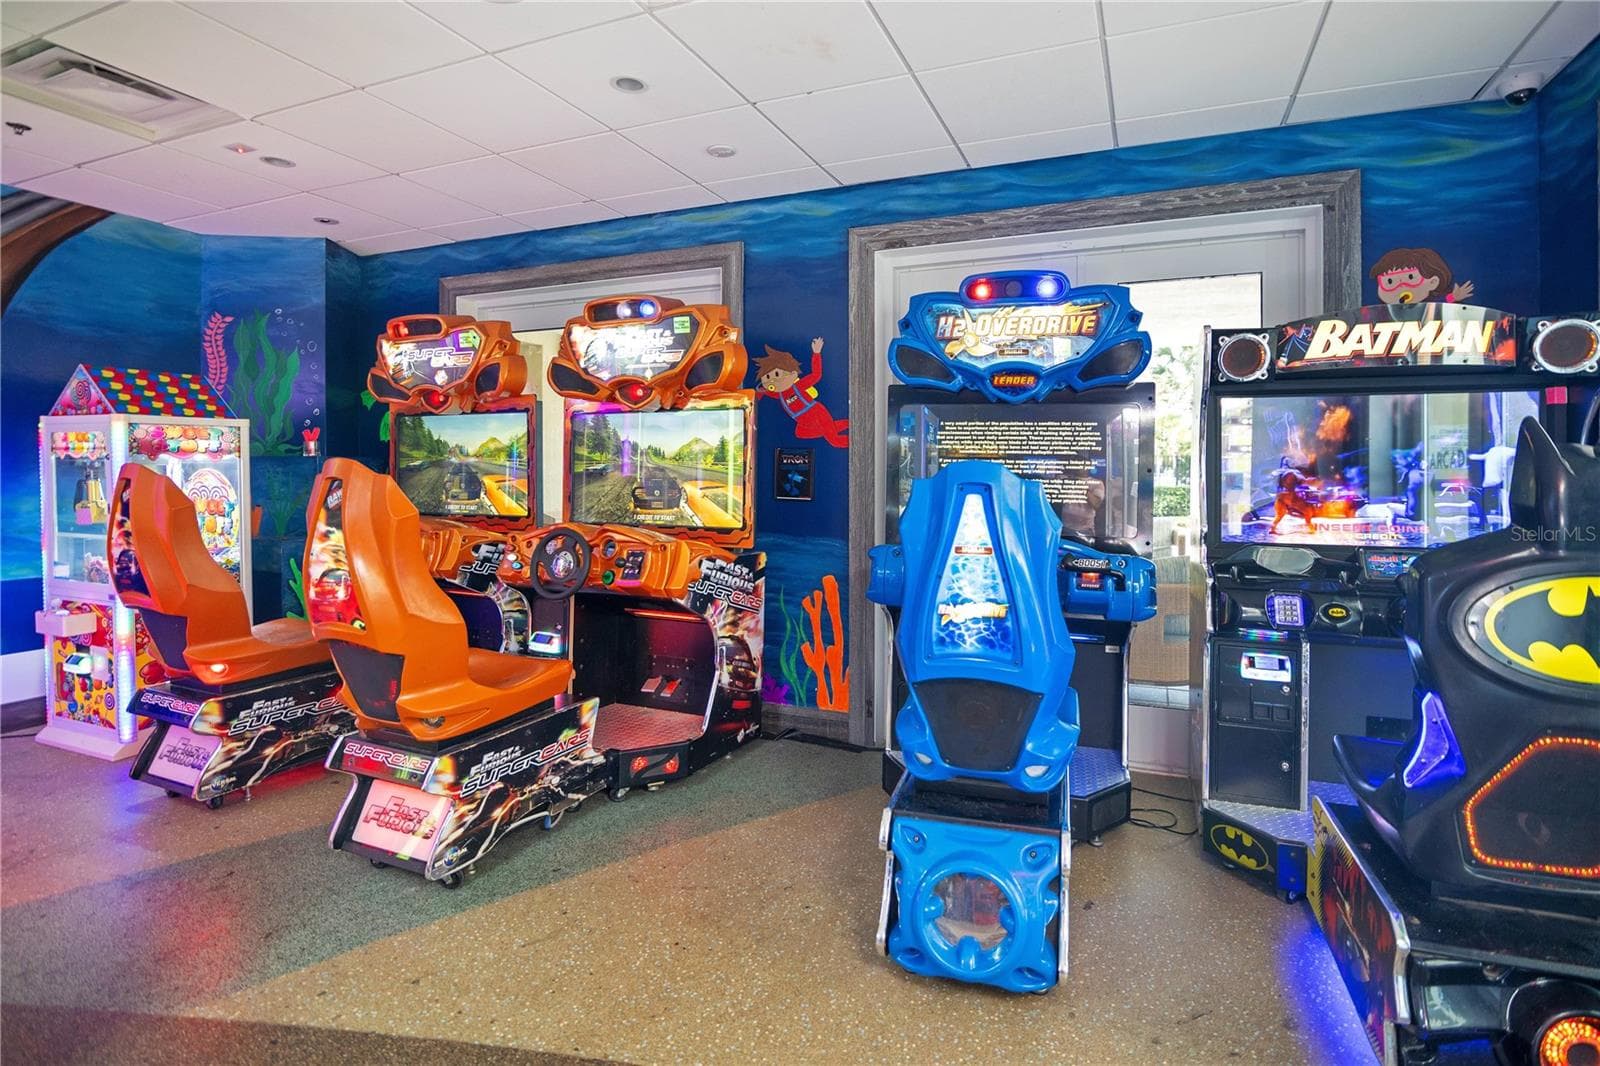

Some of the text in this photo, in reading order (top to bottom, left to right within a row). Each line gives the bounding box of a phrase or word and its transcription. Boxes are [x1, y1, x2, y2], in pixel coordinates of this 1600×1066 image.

[1303, 319, 1497, 361] BATMAN
[993, 374, 1036, 386] LEADER
[781, 455, 809, 464] TRON
[1430, 450, 1466, 469] ARCAD
[715, 558, 750, 577] FAST
[1079, 559, 1108, 569] BOOST
[700, 559, 755, 593] FURIOUS
[141, 692, 200, 717] SUPERCARS
[344, 743, 431, 774] SUPERCARS
[460, 728, 590, 798] SUPERCARS
[469, 751, 522, 776] FURIOUS
[481, 746, 515, 765] FAST
